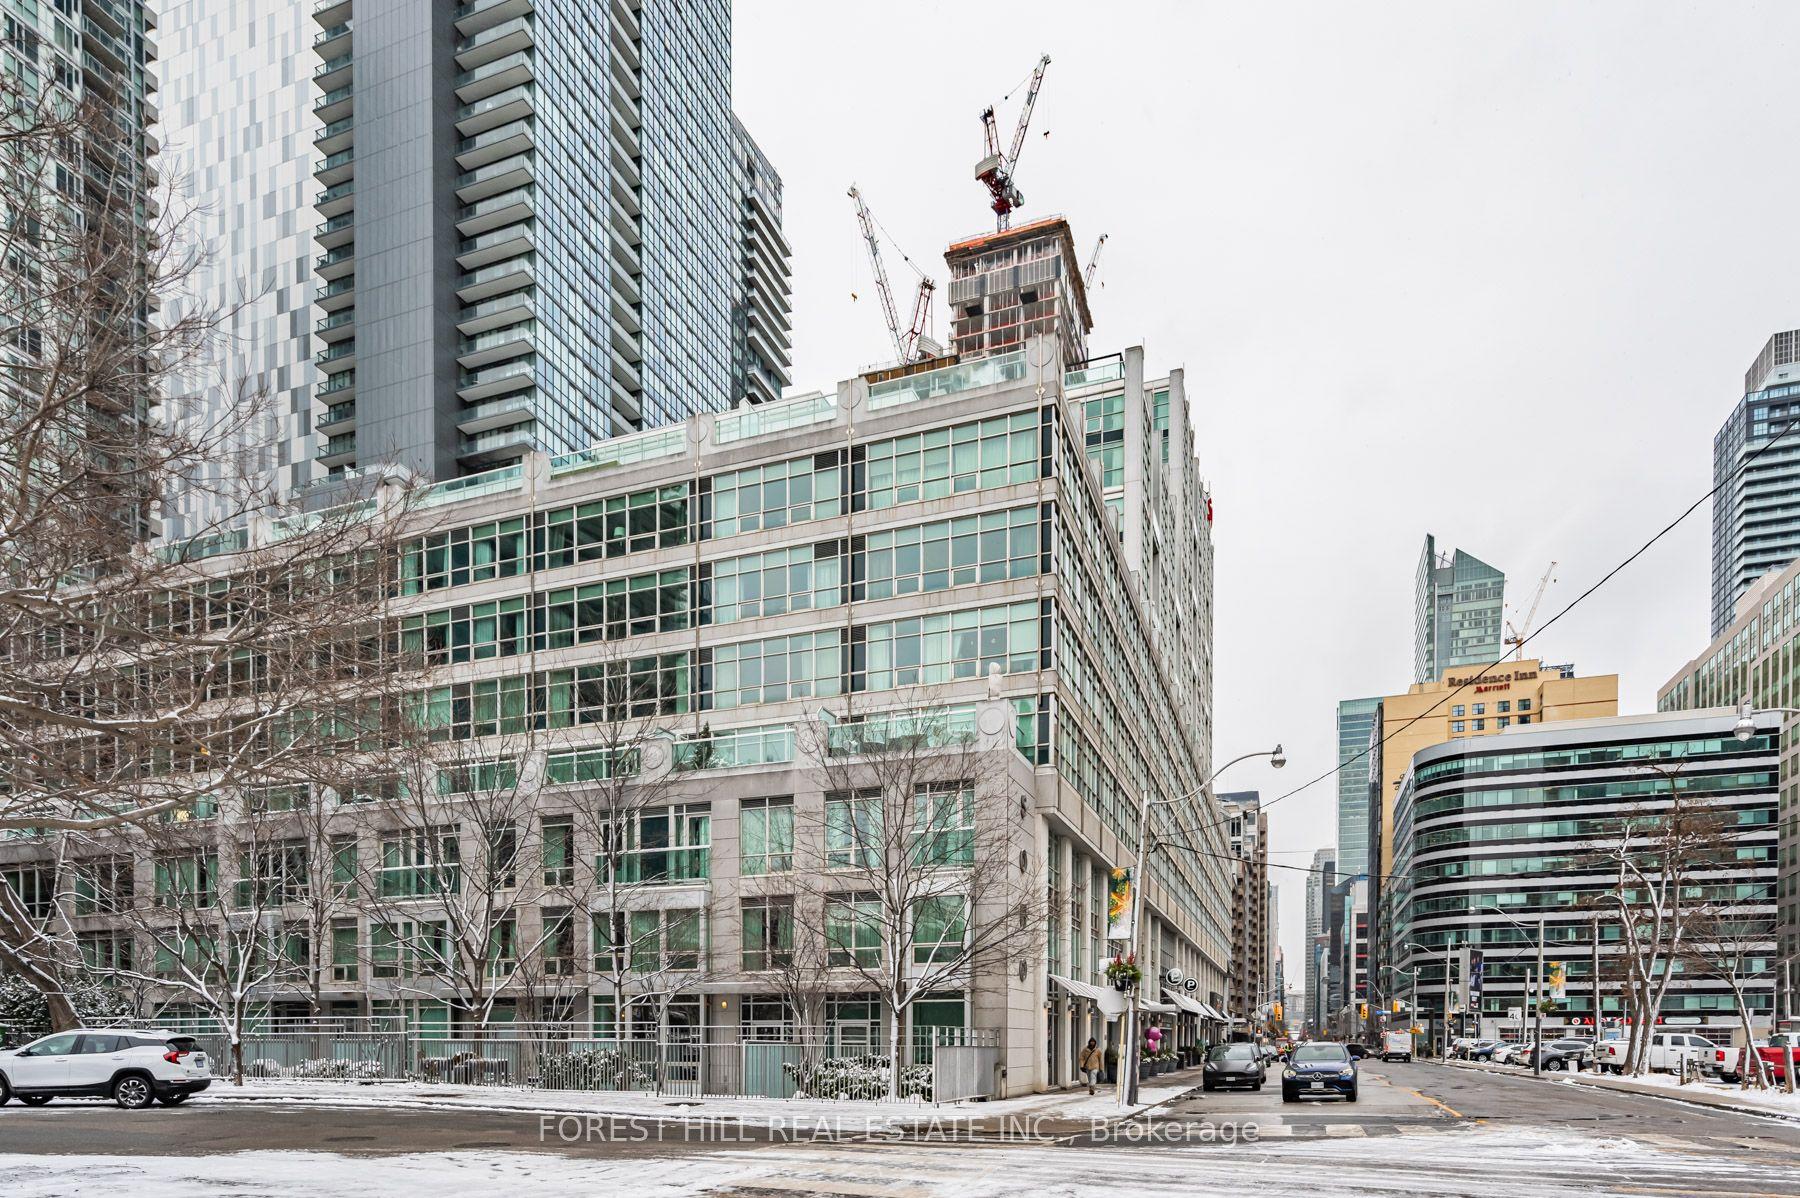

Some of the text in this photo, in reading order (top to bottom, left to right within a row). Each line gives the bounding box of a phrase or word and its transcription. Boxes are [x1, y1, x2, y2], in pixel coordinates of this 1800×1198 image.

[1448, 670, 1538, 687] Residence Inn
[1474, 683, 1510, 694] Marriott
